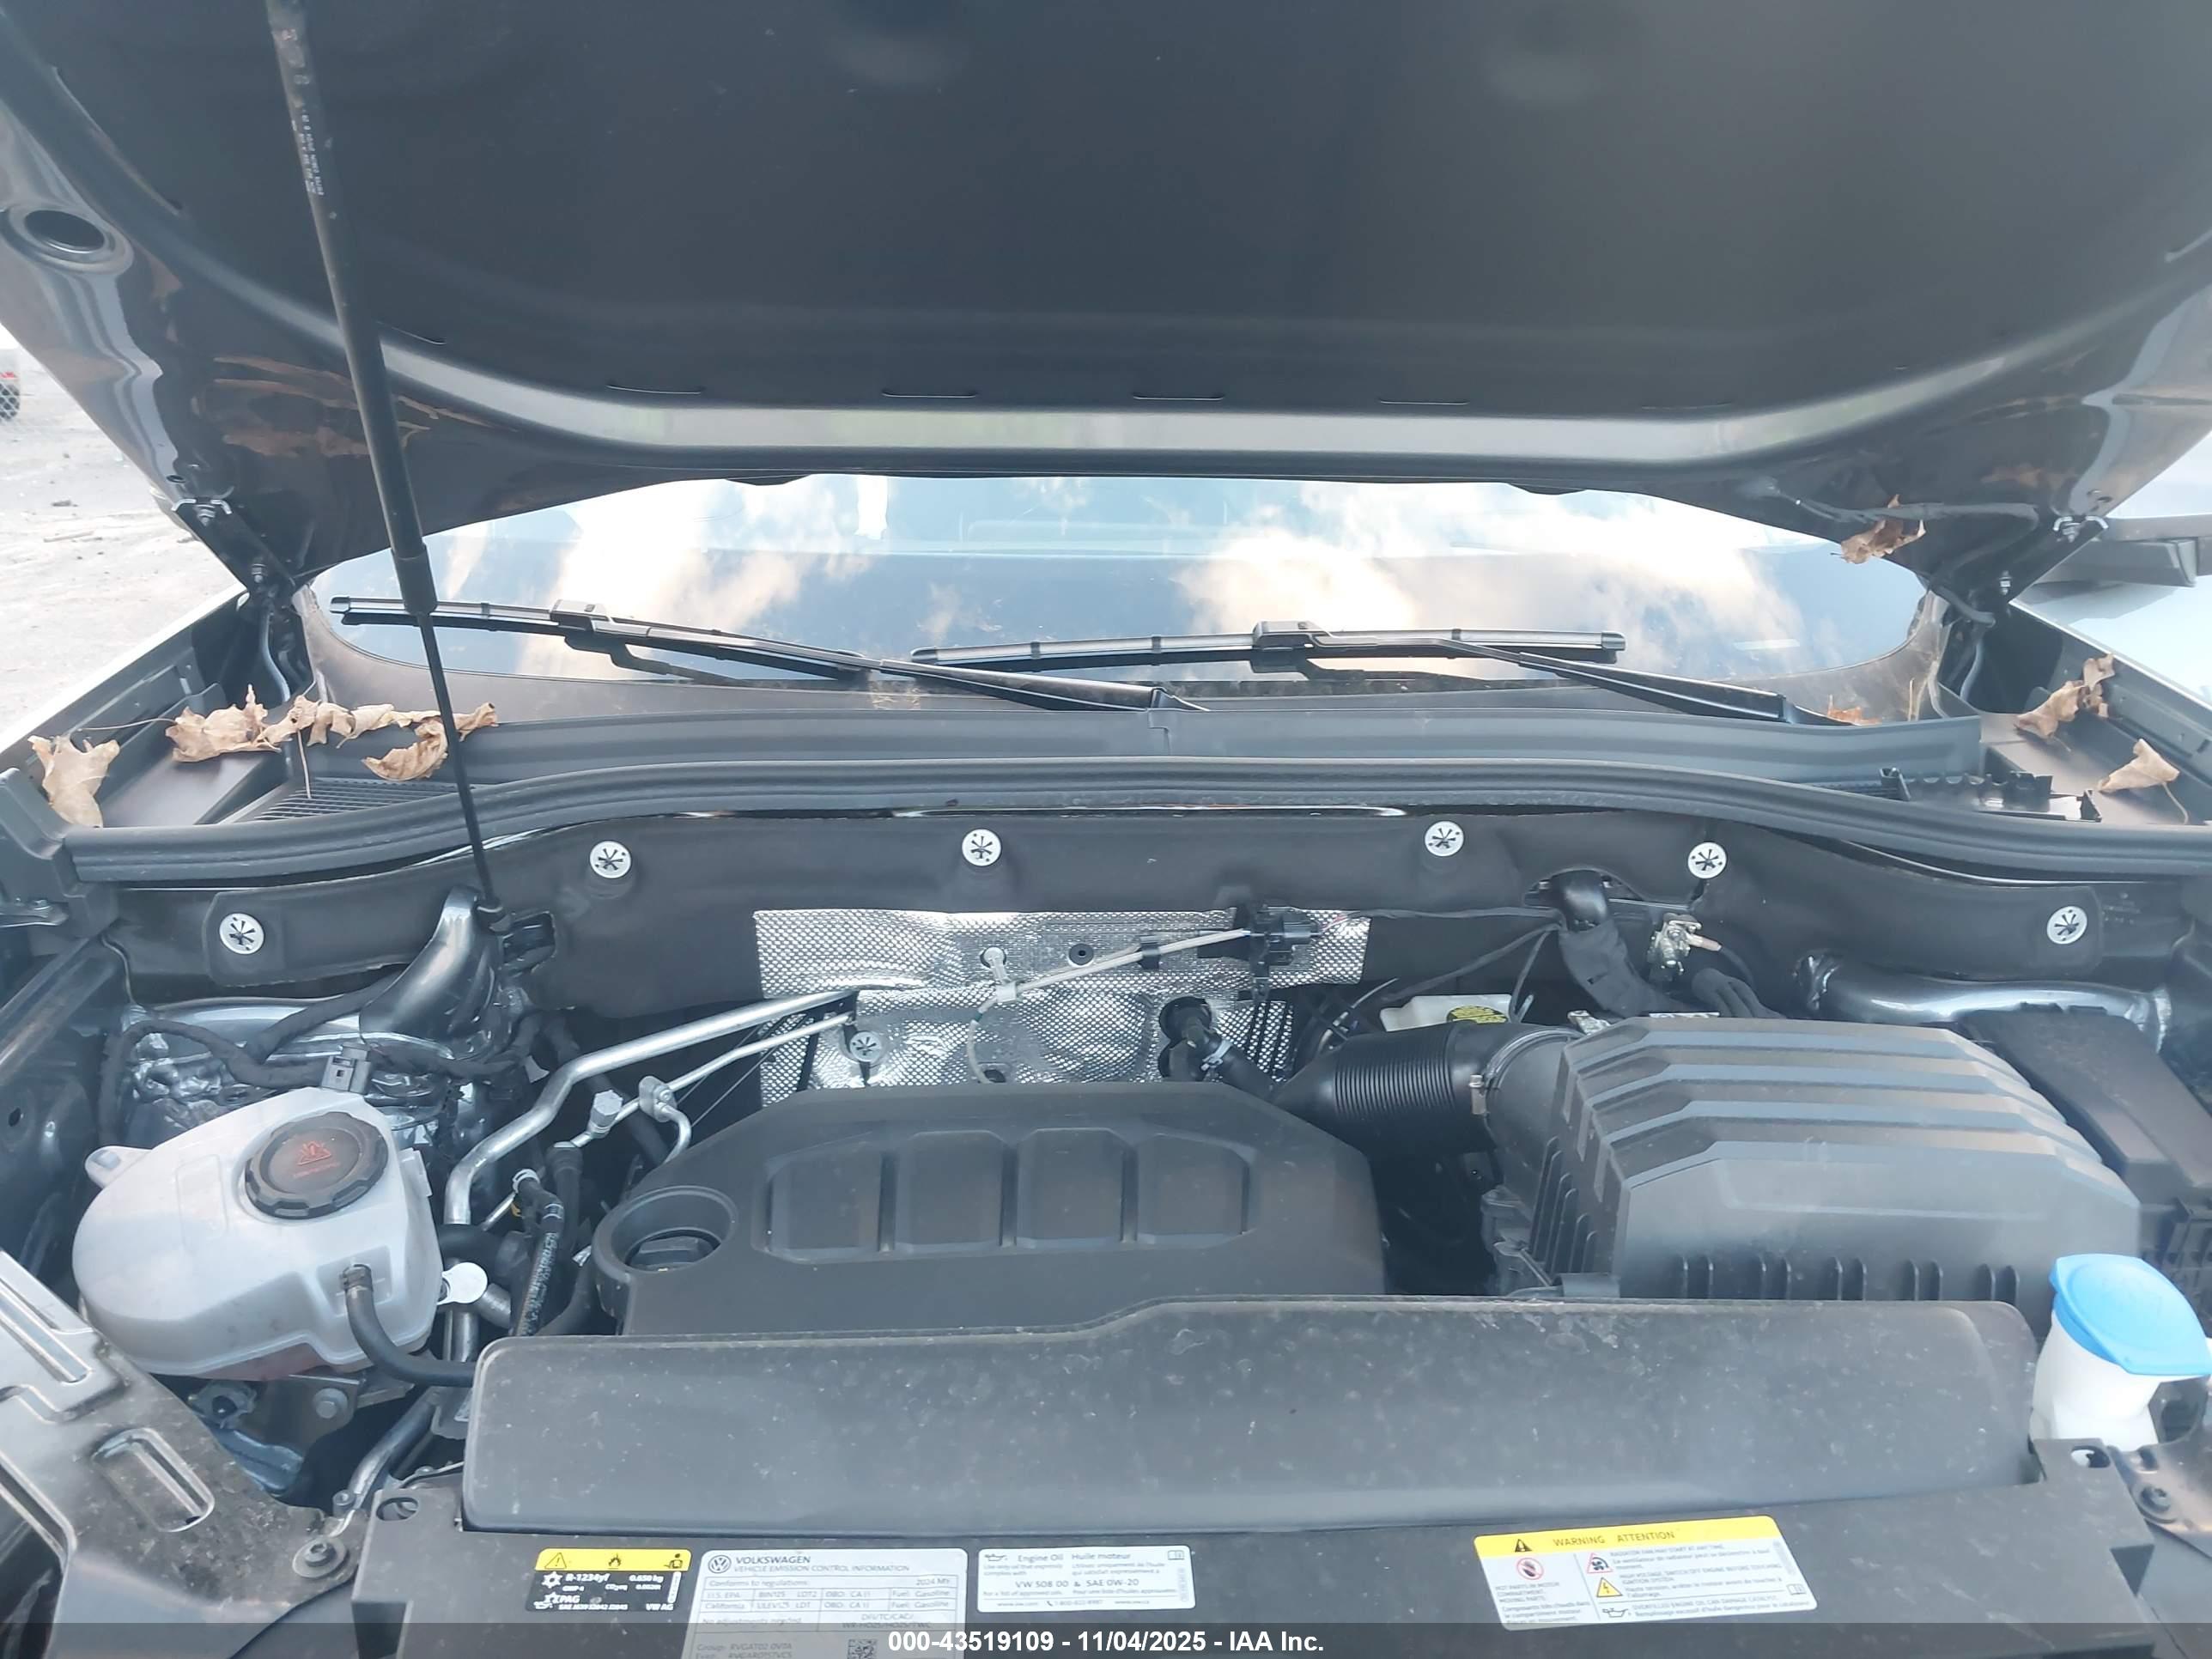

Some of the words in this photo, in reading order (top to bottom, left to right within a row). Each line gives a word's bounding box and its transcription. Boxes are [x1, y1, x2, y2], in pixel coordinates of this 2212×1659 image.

[1553, 1535, 1605, 1546] WARNING
[1617, 1532, 1675, 1542] ATTENTION
[735, 1555, 811, 1564] VOLKSWAGEN
[565, 1573, 610, 1583] R-1234yf
[653, 1575, 665, 1583] kg
[559, 1595, 580, 1604] PAG
